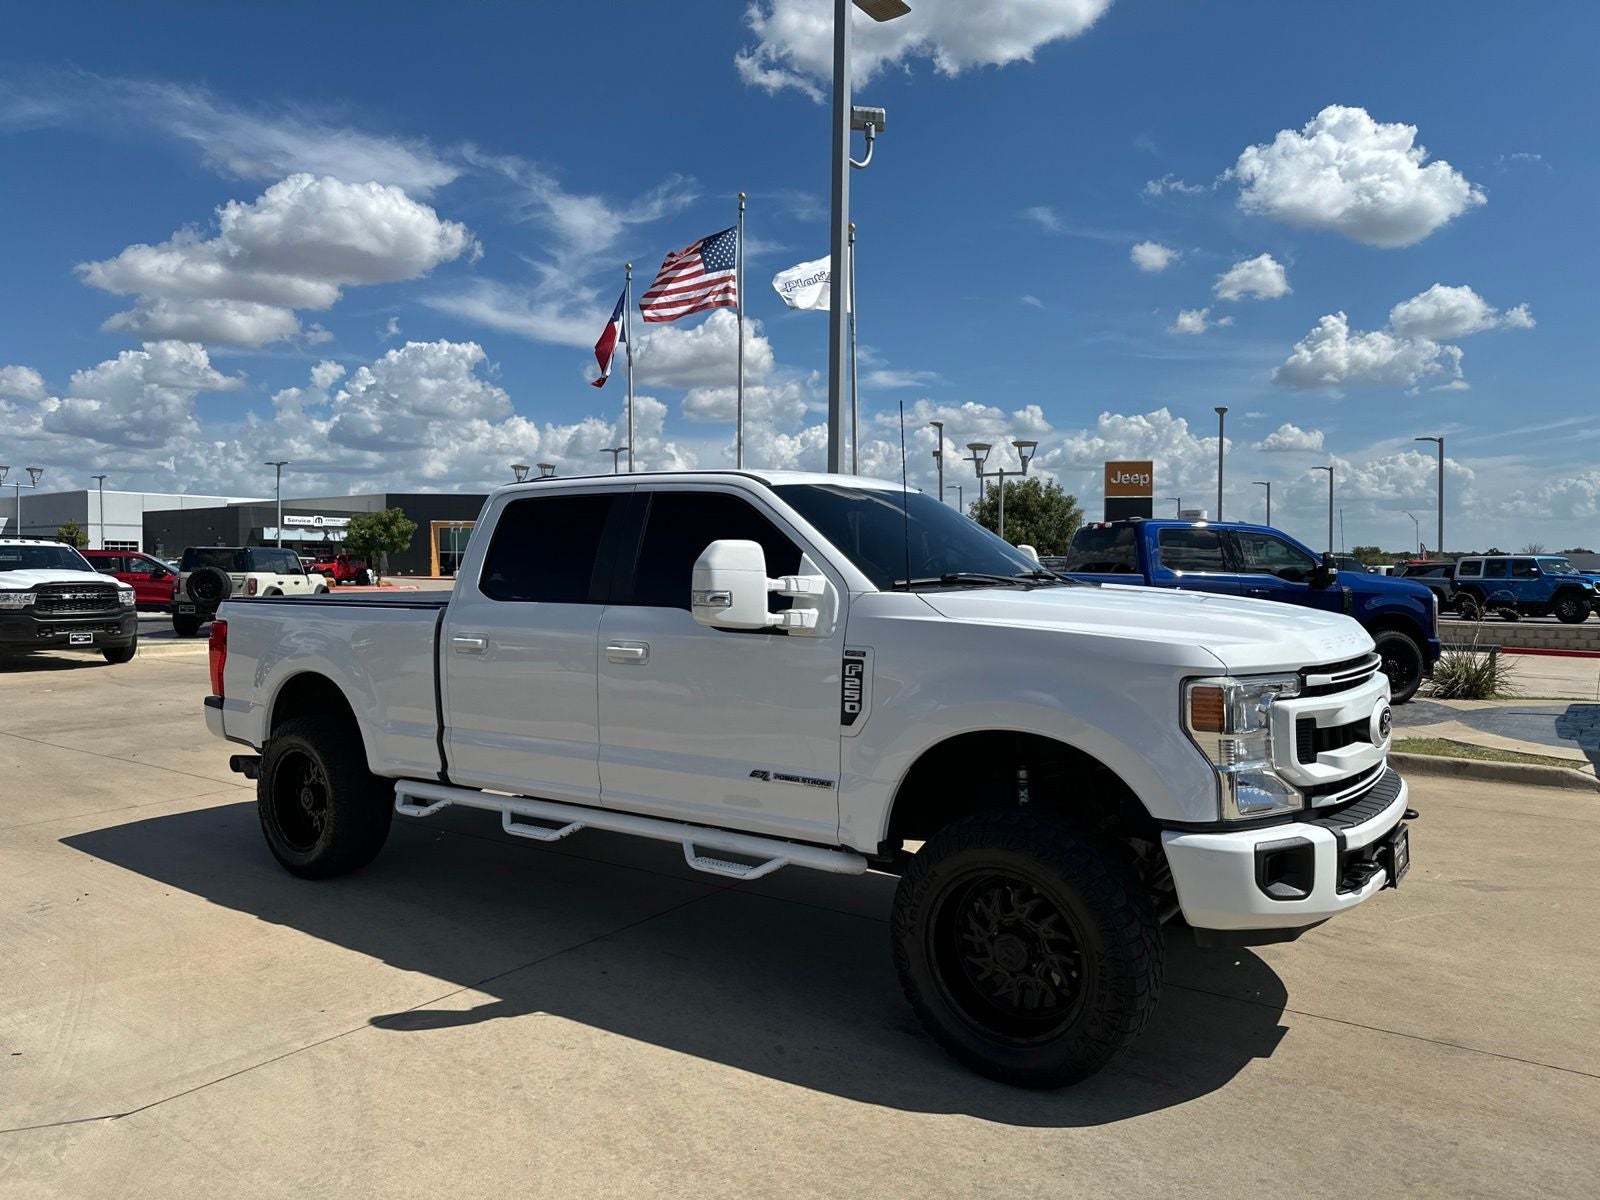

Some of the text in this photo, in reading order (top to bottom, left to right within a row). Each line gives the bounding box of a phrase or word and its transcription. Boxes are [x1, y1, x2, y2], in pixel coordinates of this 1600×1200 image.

[1110, 470, 1150, 487] Jeep
[773, 773, 800, 783] POWER
[800, 776, 833, 788] STROKE
